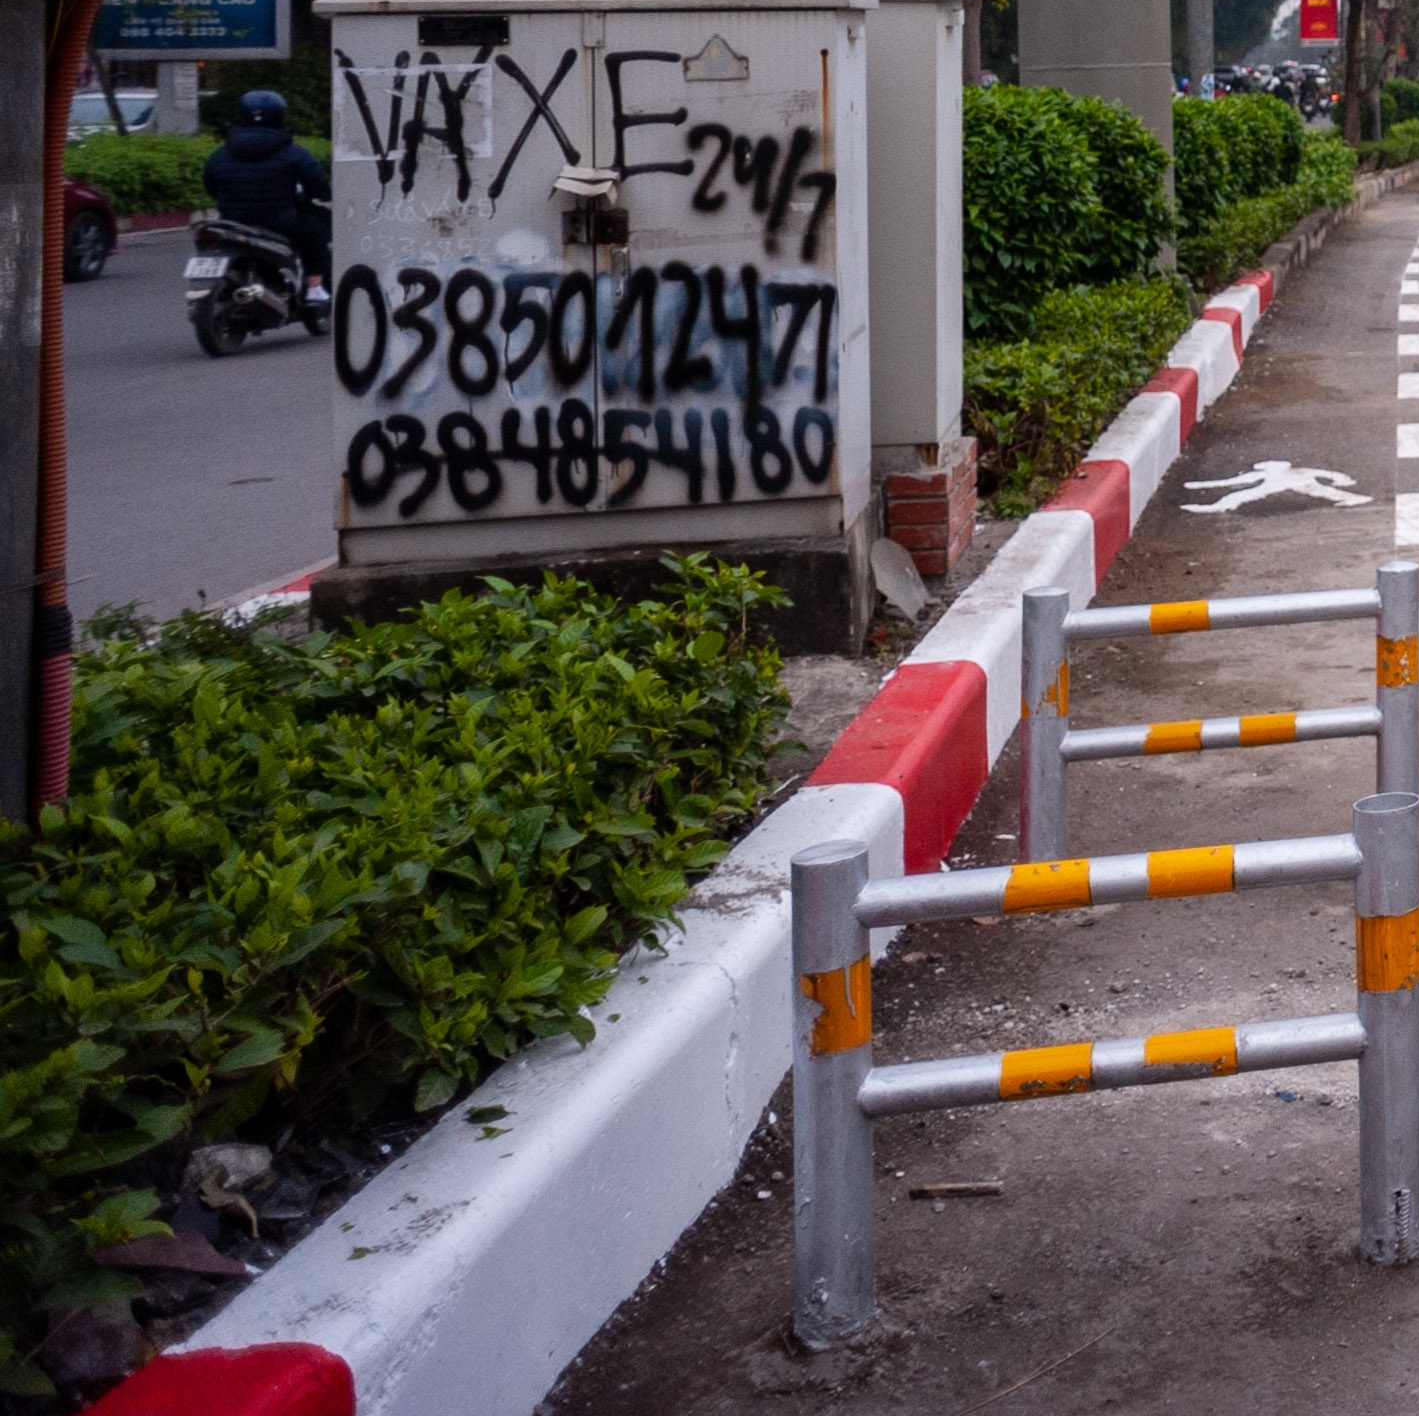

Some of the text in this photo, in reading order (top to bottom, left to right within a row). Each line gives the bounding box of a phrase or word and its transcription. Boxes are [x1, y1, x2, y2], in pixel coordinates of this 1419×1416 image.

[488, 48, 695, 200] XE
[687, 123, 837, 262] 24/7
[334, 260, 837, 402] 0385012471
[348, 398, 835, 518] 0384854180
